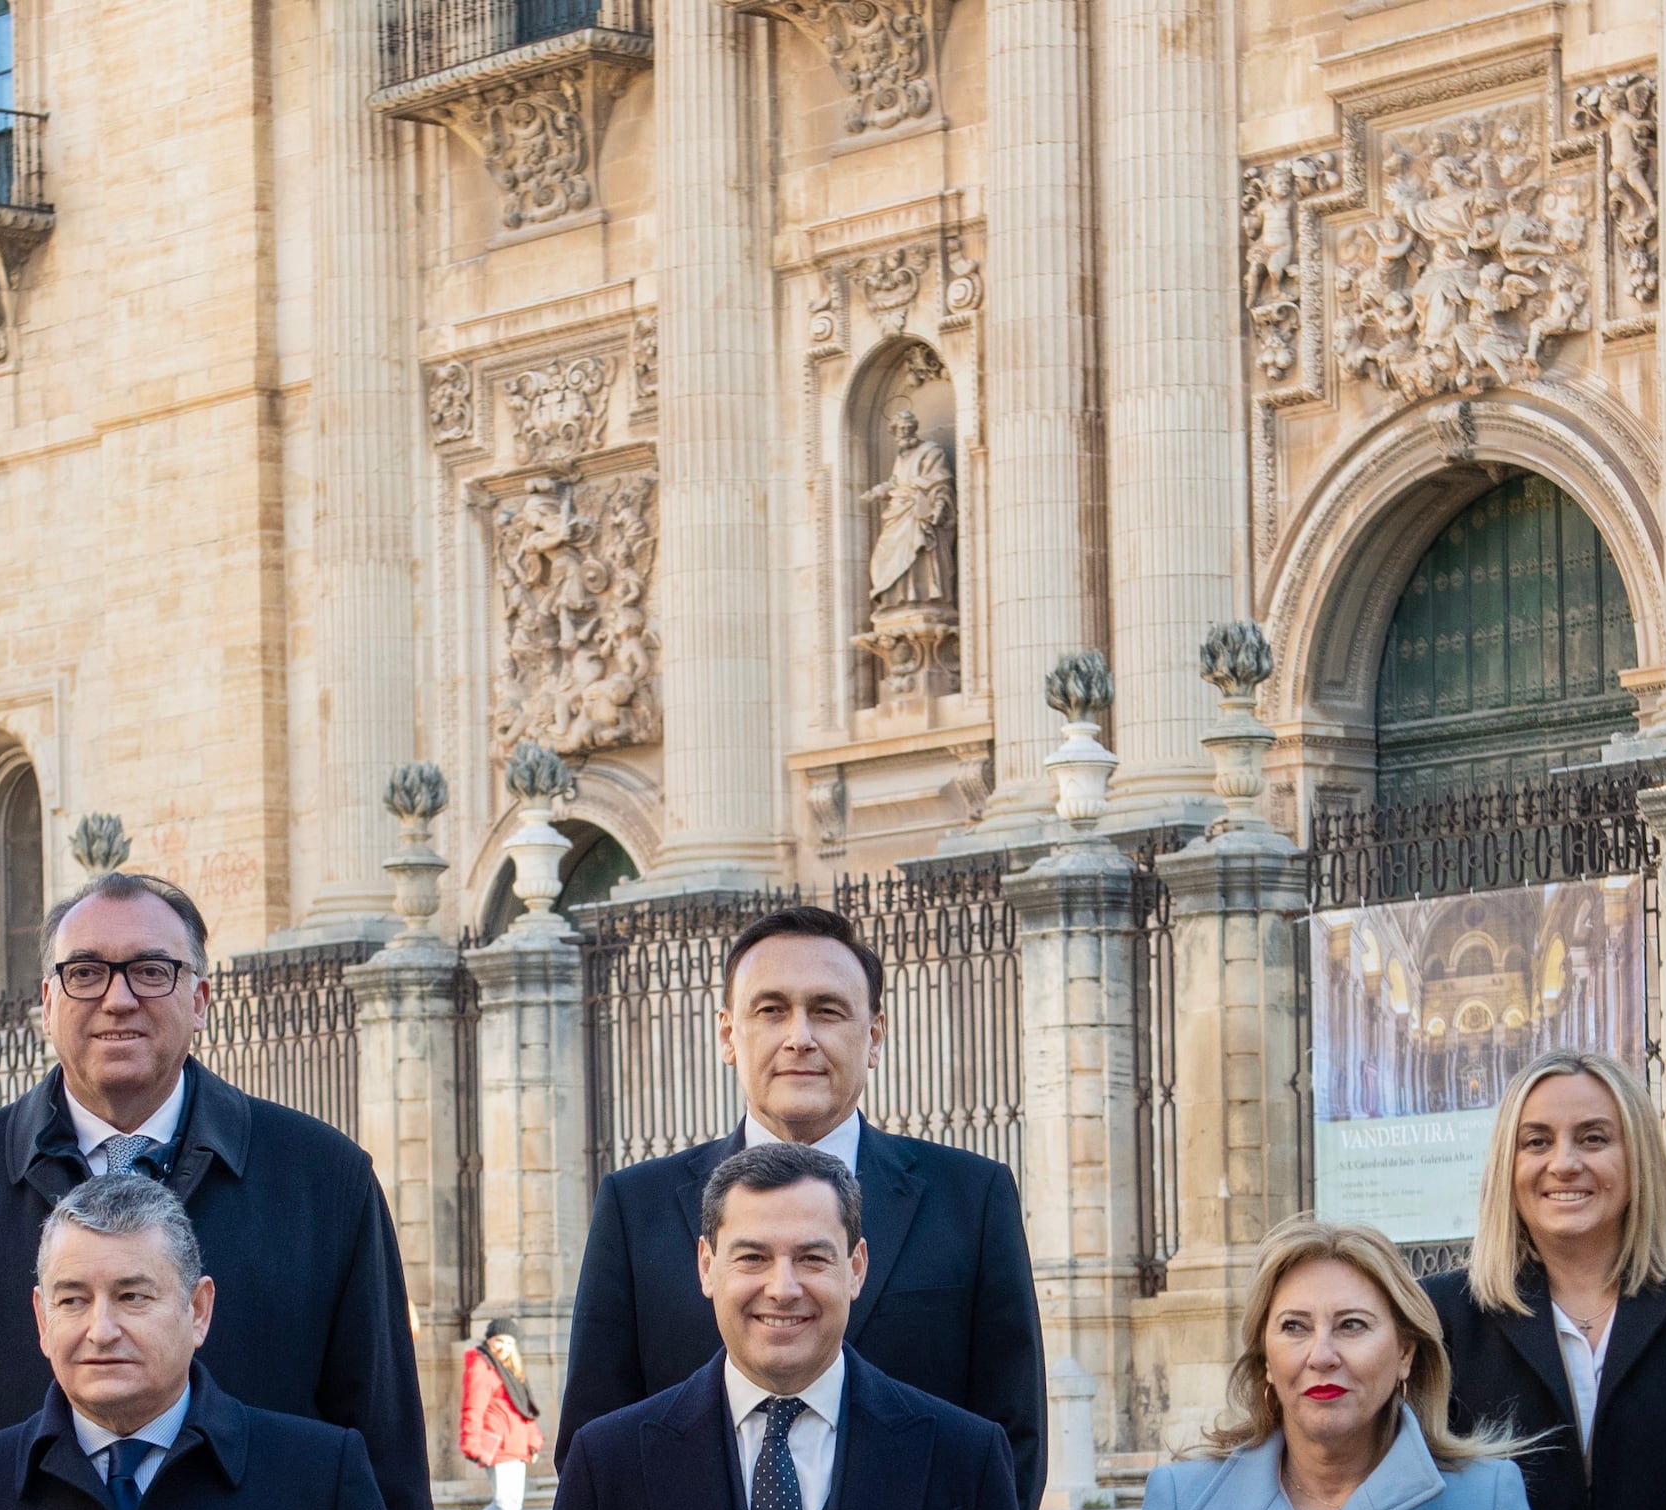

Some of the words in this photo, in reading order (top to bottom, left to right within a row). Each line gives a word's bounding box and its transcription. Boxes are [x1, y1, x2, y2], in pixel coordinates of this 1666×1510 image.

[1341, 1121, 1455, 1148] VANDELVIRA
[1354, 1157, 1388, 1170] Catedral
[1453, 1151, 1473, 1162] Altas
